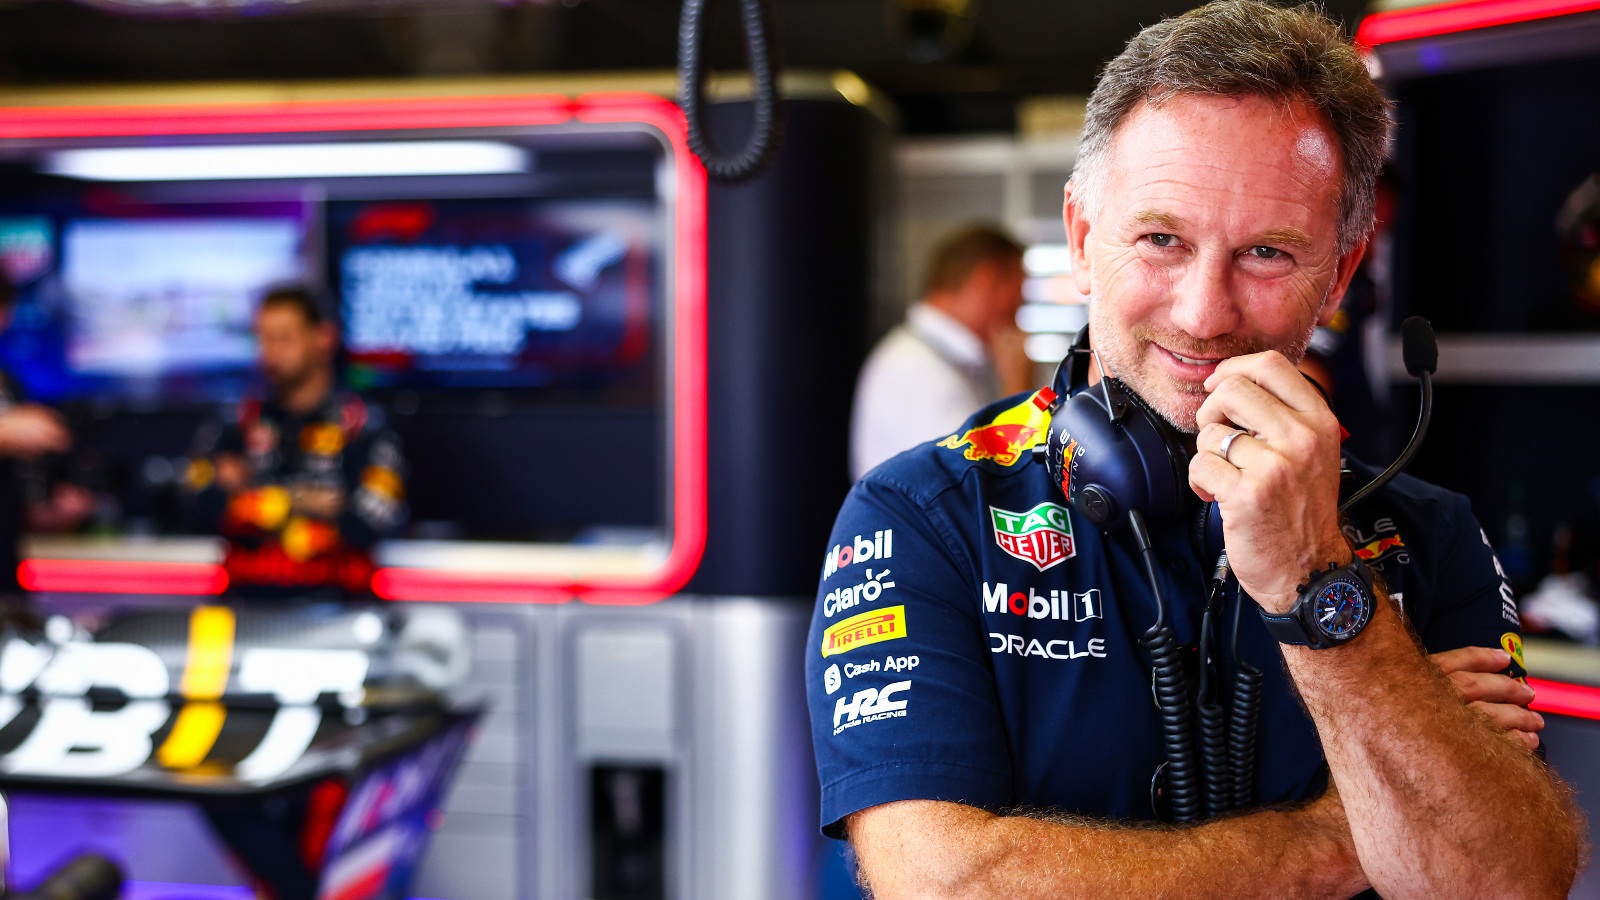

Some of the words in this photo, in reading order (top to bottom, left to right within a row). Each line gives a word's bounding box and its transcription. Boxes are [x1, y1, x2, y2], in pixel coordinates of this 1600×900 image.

[1053, 428, 1071, 489] RACLE
[997, 508, 1066, 533] TAG
[824, 529, 893, 581] Mobil
[1000, 532, 1071, 564] HEUER
[824, 575, 884, 618] Claro
[982, 582, 1069, 621] Mobil
[828, 613, 896, 649] PIRELLI
[989, 632, 1108, 660] ORACLE
[844, 662, 880, 678] Cash
[883, 655, 920, 672] App
[833, 679, 912, 728] HRC
[862, 709, 907, 724] RACING
